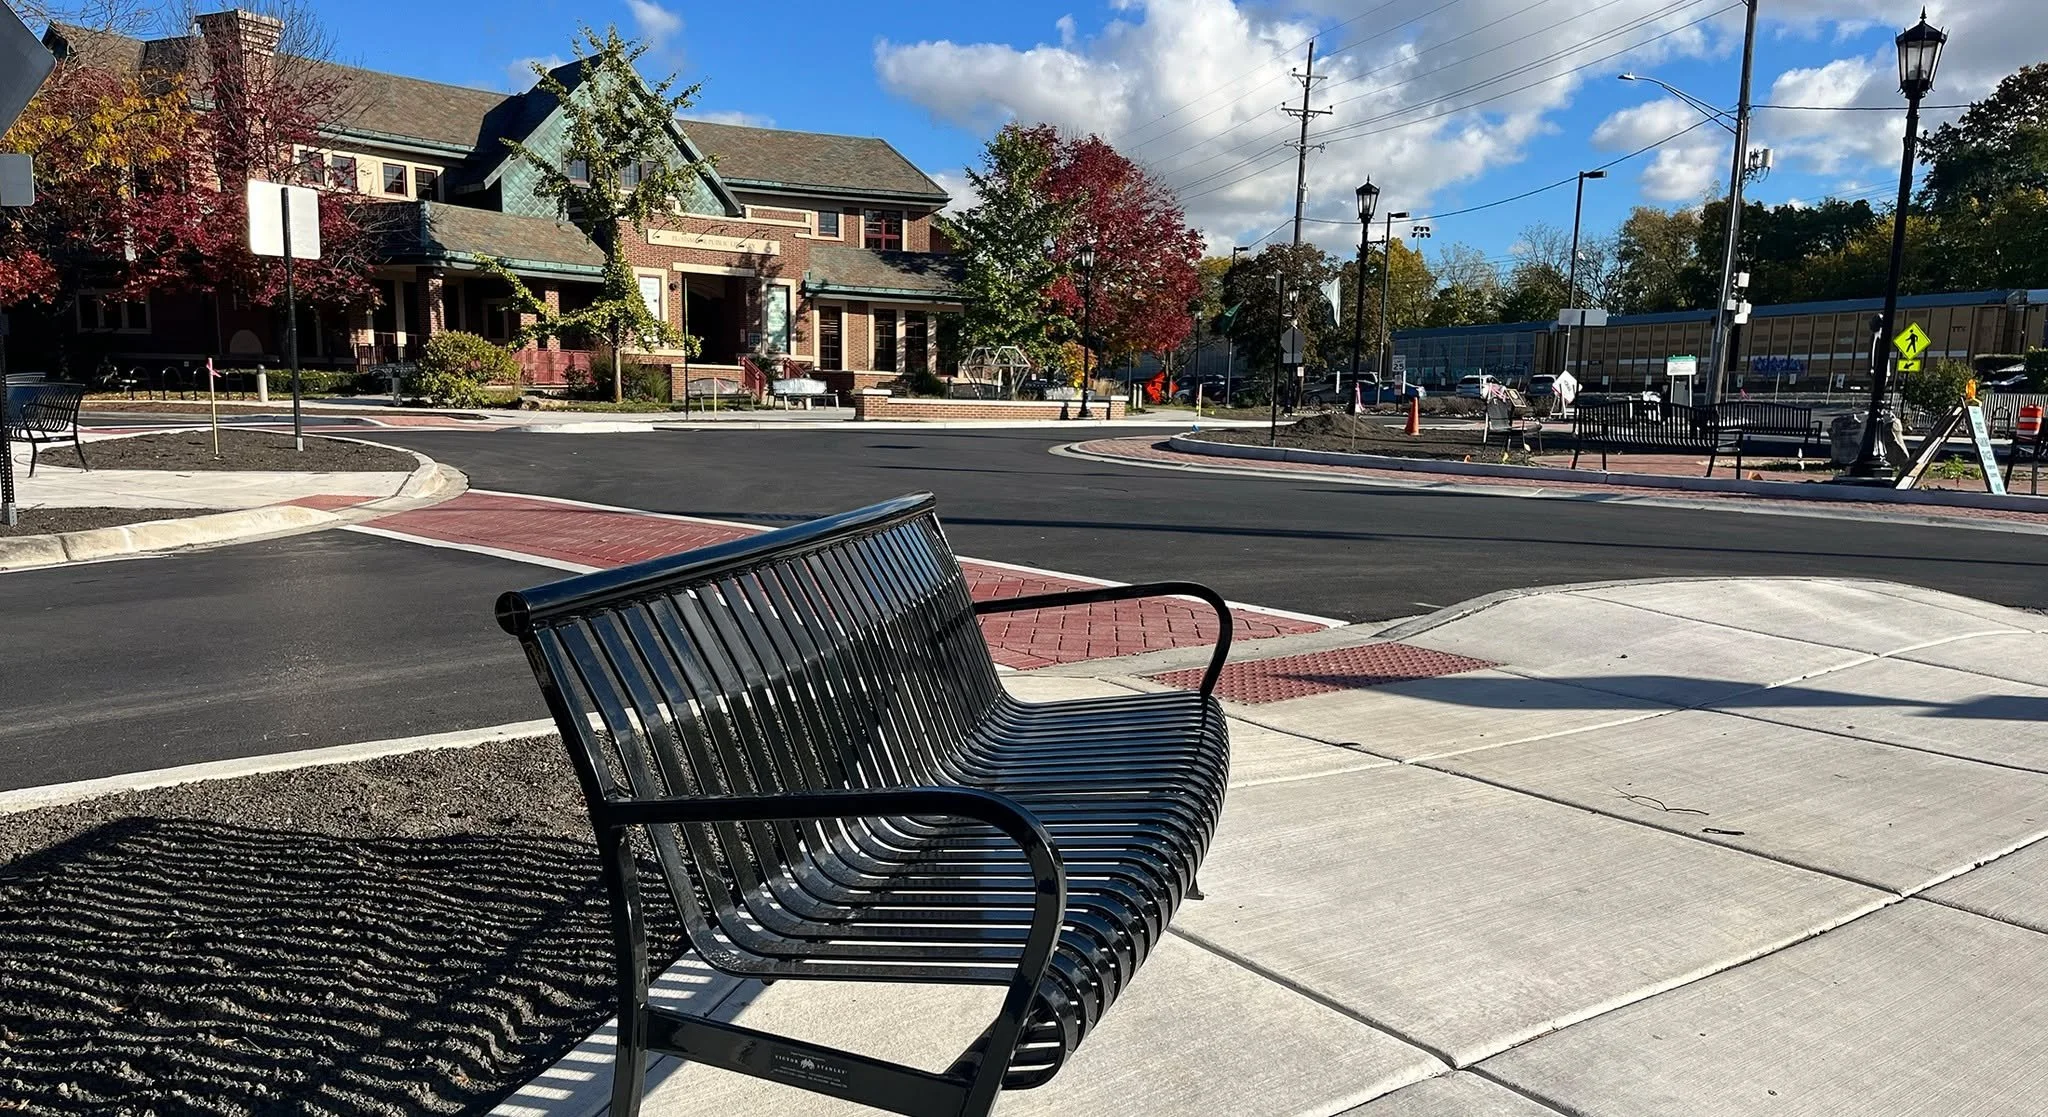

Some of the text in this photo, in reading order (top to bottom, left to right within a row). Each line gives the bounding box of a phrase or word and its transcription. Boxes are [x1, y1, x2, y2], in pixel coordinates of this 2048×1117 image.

[671, 235, 707, 245] FLOSSMR
[730, 241, 756, 249] LIARY
[775, 1055, 798, 1064] VICTOR
[817, 1064, 846, 1074] STANLEY
